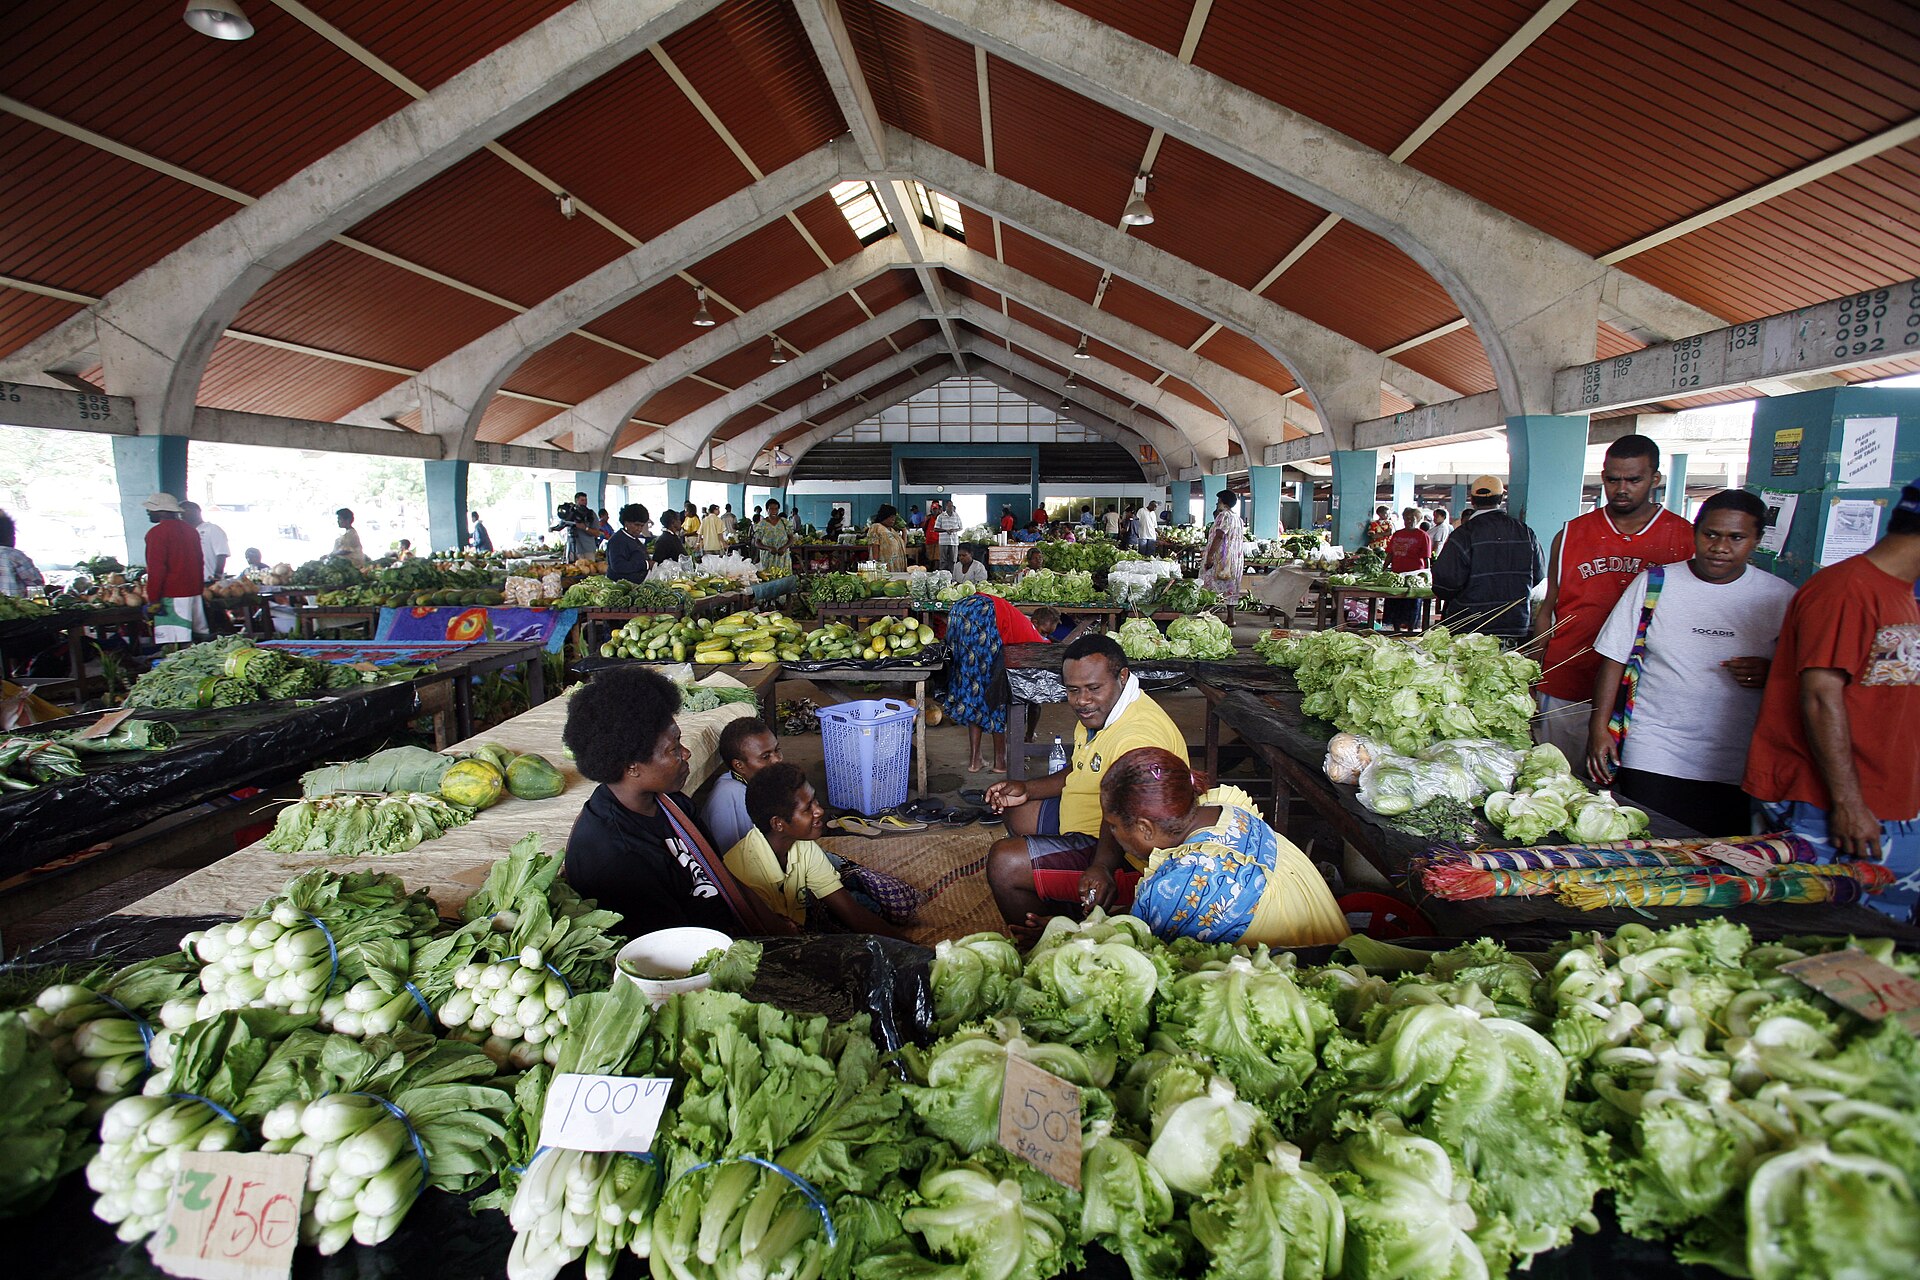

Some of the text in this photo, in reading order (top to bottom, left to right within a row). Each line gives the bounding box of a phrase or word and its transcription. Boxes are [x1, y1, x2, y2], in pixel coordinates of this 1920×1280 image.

[1838, 305, 1887, 326] 090
[1729, 324, 1760, 340] 103
[1836, 321, 1881, 341] 091
[1672, 337, 1702, 353] 099
[1728, 335, 1758, 352] 104
[1834, 338, 1885, 358] 092
[1614, 357, 1632, 368] 109
[1673, 349, 1701, 364] 100
[1584, 364, 1601, 375] 105
[1613, 367, 1629, 378] 110
[1672, 362, 1698, 376] 101
[1583, 373, 1600, 385] 106
[1671, 375, 1700, 388] 102
[1582, 384, 1600, 395] 107
[1582, 394, 1600, 405] 108
[1691, 627, 1735, 637] SOCADIS
[1011, 1088, 1069, 1143] 50
[199, 1175, 298, 1259] 150
